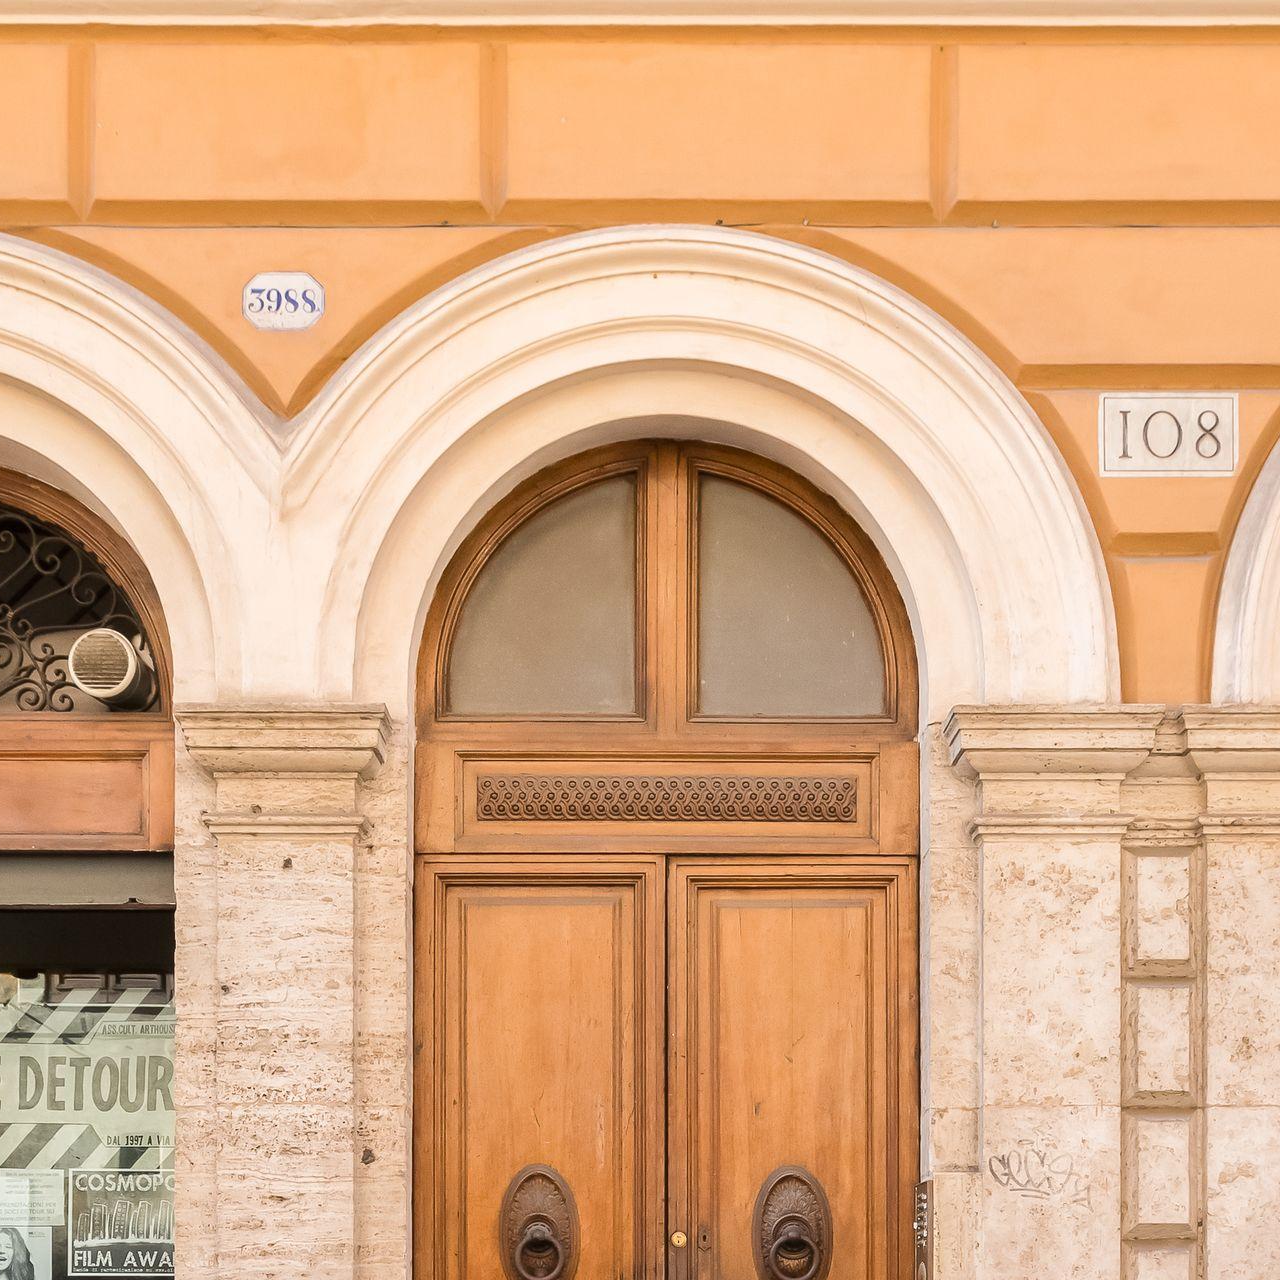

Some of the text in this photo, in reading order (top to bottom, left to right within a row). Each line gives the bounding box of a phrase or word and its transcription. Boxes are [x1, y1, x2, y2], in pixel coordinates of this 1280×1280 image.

[248, 288, 317, 314] 3988
[1118, 409, 1221, 460] 108
[18, 1055, 176, 1113] DETOUR
[106, 1135, 170, 1146] DAL 1997 A VIA
[73, 1250, 175, 1268] FILM AWA
